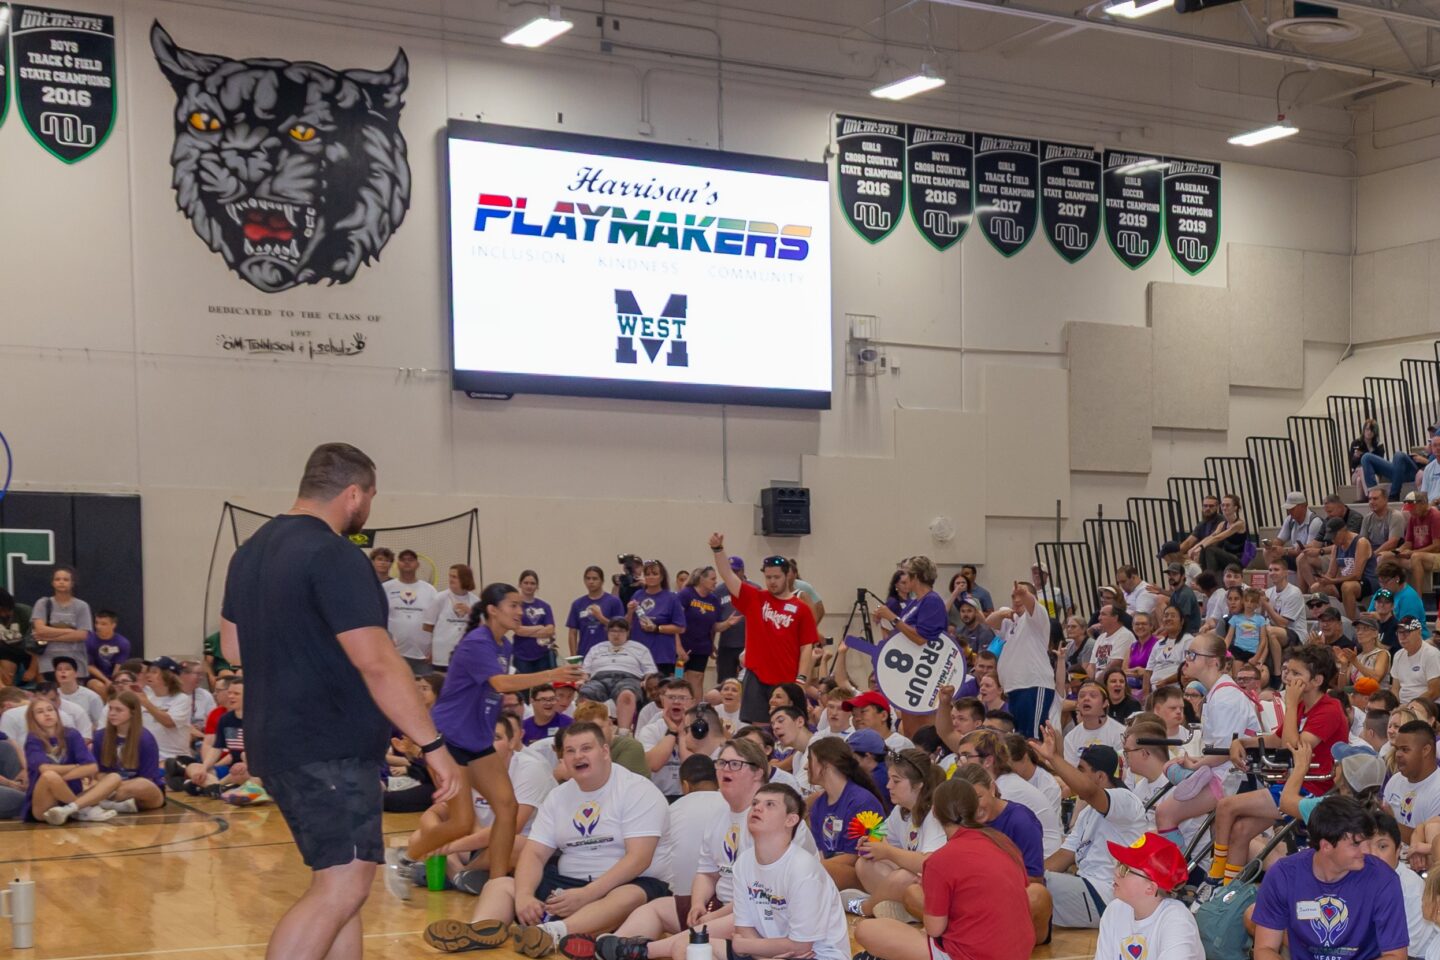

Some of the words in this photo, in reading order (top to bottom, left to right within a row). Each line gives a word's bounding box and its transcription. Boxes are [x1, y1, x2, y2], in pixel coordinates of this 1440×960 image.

[50, 39, 79, 53] BOYS
[27, 52, 63, 67] TRACK
[74, 58, 103, 72] FIELD
[20, 67, 52, 81] STATE
[52, 71, 112, 88] CHAMPIONS
[41, 86, 92, 107] 2016
[862, 142, 881, 152] GIRLS
[845, 152, 866, 163] CROSS
[867, 155, 898, 167] COUNTRY
[932, 151, 950, 162] BOYS
[841, 164, 862, 176] STATE
[864, 167, 902, 180] CHAMPIONS
[914, 162, 934, 173] CROSS
[936, 165, 966, 176] COUNTRY
[998, 162, 1016, 171] GIRLS
[1062, 166, 1080, 176] GIRLS
[567, 165, 720, 207] Harrison's
[912, 174, 931, 185] STATE
[933, 176, 970, 189] CHAMPIONS
[984, 172, 1006, 183] TRACK
[1012, 174, 1029, 185] FIELD
[1047, 176, 1066, 186] CROSS
[1067, 178, 1095, 190] COUNTRY
[1124, 176, 1142, 186] GIRLS
[857, 180, 890, 197] 2016
[979, 184, 998, 194] STATE
[1000, 187, 1035, 198] CHAMPIONS
[1044, 188, 1062, 198] STATE
[1064, 190, 1099, 203] CHAMPIONS
[1122, 188, 1144, 199] SOCCER
[1175, 182, 1210, 194] BASEBALL
[925, 189, 957, 205] 2016
[1181, 194, 1204, 205] STATE
[992, 198, 1021, 214] 2017
[1058, 202, 1087, 218] 2017
[1106, 198, 1125, 208] STATE
[1126, 201, 1160, 213] CHAMPIONS
[1171, 204, 1213, 218] CHAMPIONS
[473, 192, 813, 262] PLAYMAKERS
[1119, 212, 1148, 228] 2019
[1178, 218, 1207, 233] 2019
[471, 244, 566, 265] INCLUSION
[597, 254, 680, 277] KINDNESS
[707, 264, 806, 285] COMMUNITY
[208, 305, 272, 317] DEDICATED
[280, 310, 294, 318] TO
[301, 311, 322, 319] THE
[328, 312, 361, 321] CLASS
[617, 314, 686, 339] WEST
[884, 648, 914, 674] 8
[905, 637, 944, 707] GROUP
